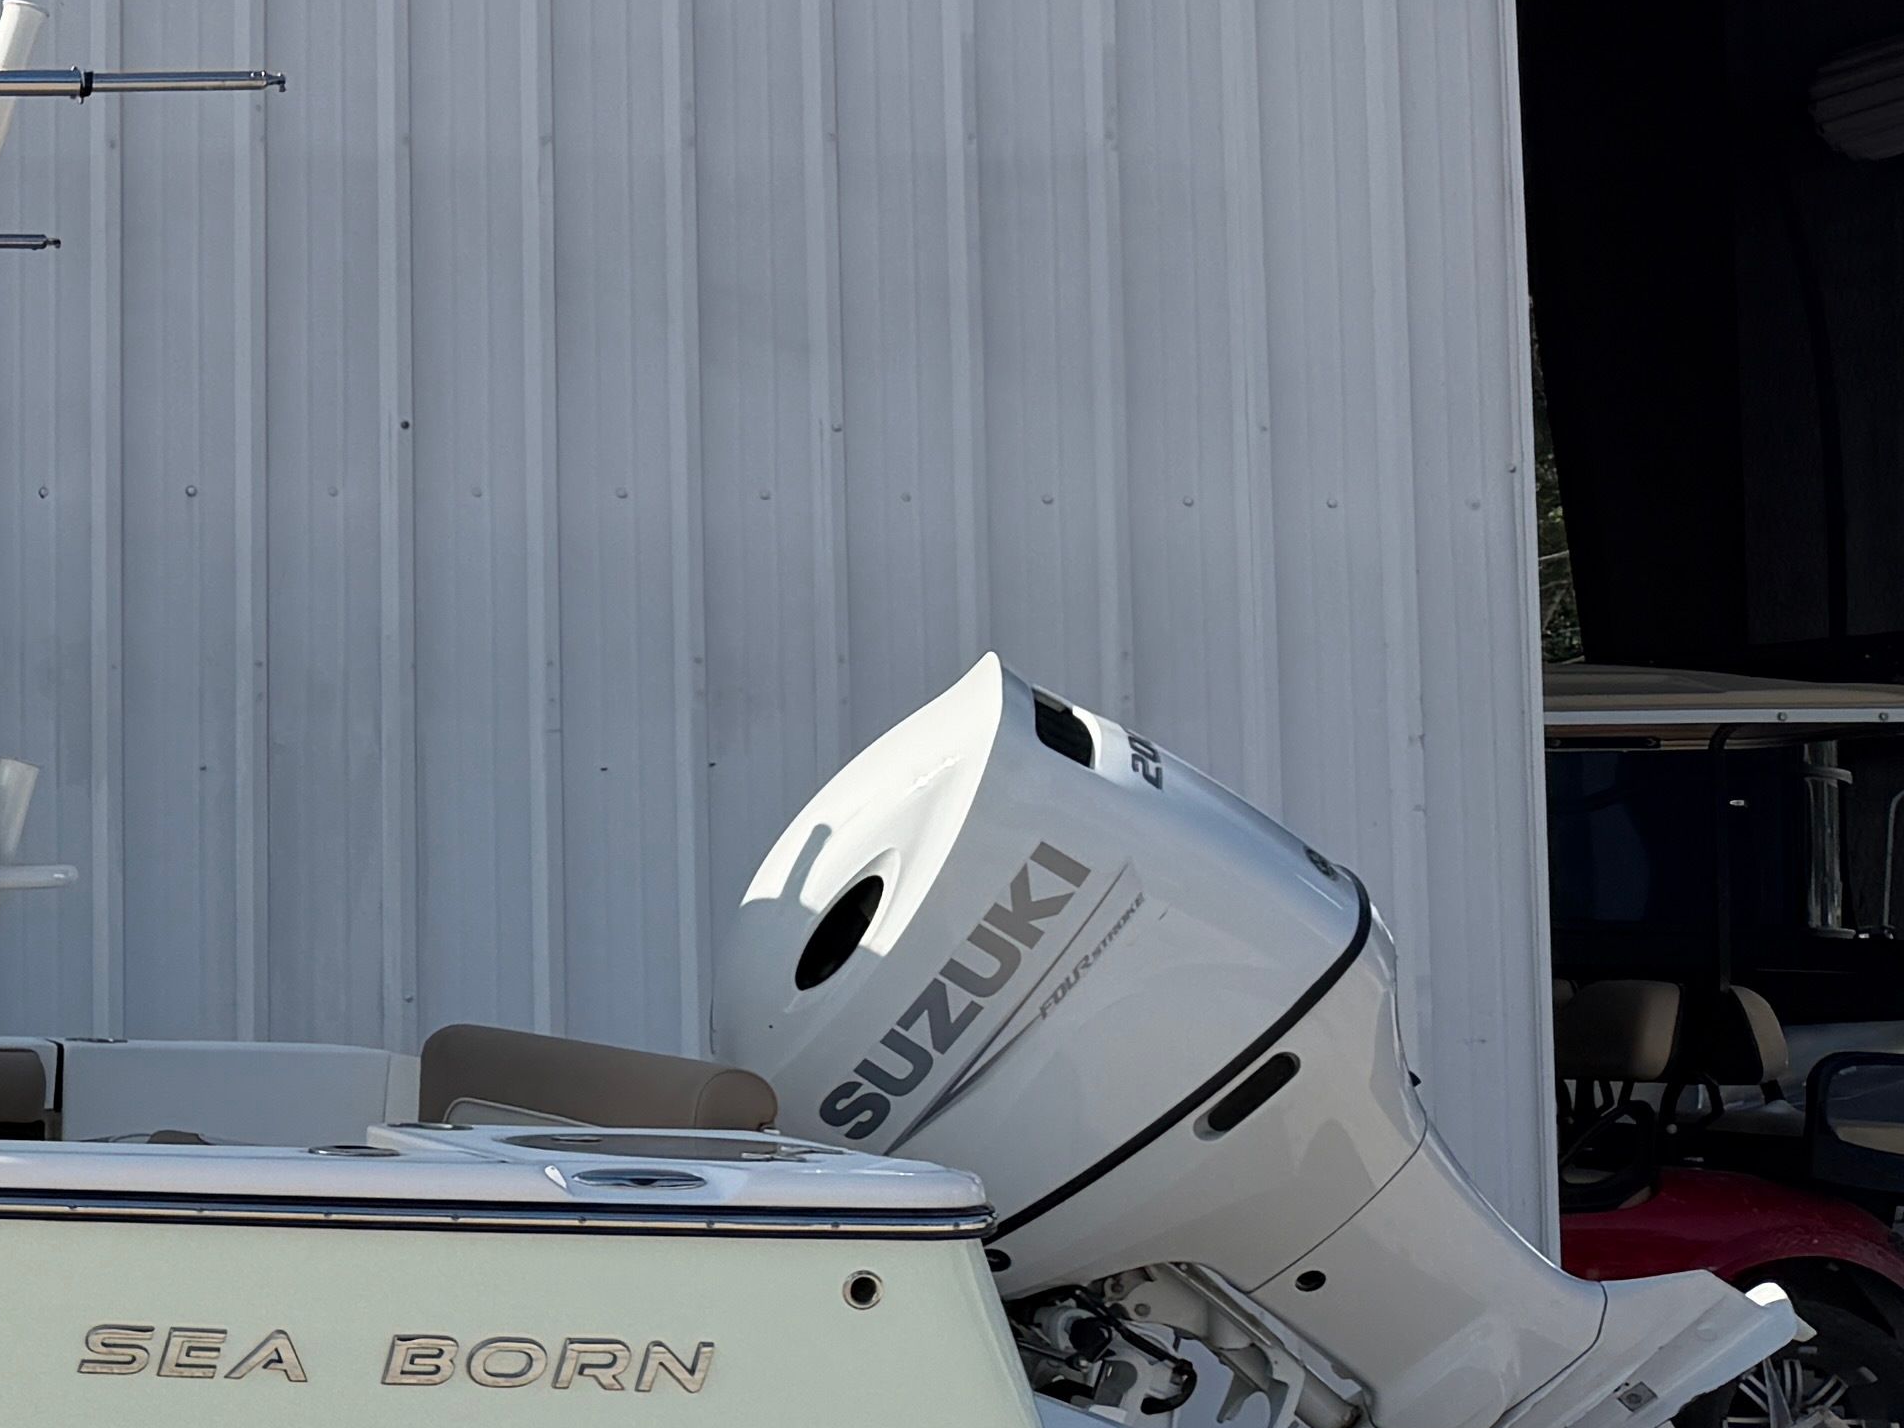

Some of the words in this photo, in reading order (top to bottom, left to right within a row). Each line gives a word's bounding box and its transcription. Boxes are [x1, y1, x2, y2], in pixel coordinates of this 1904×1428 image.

[819, 841, 1092, 1140] SUZUKI
[77, 1324, 309, 1383] SEA
[380, 1334, 716, 1394] BORN
